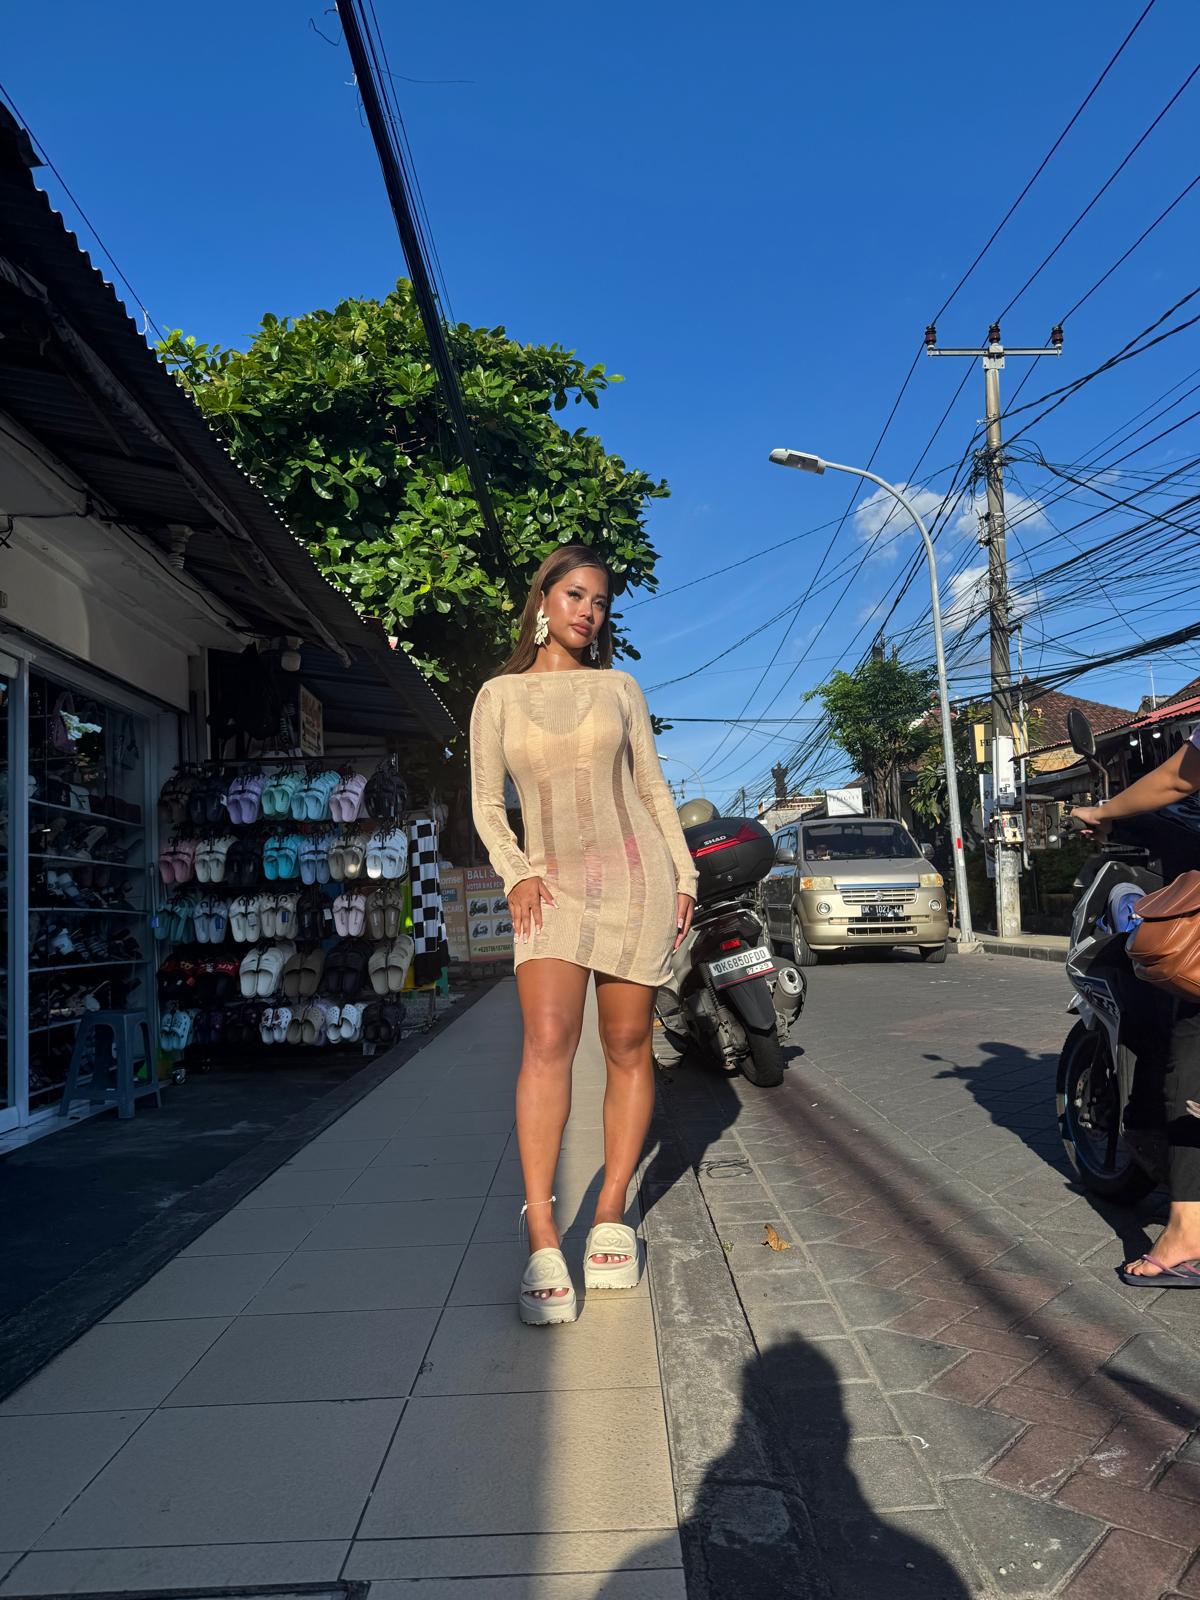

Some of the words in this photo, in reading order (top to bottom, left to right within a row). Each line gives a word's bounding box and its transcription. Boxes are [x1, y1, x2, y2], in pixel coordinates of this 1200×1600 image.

[703, 835, 727, 846] SHAD
[467, 869, 487, 880] BALI
[489, 869, 496, 878] S
[875, 905, 890, 913] 1027
